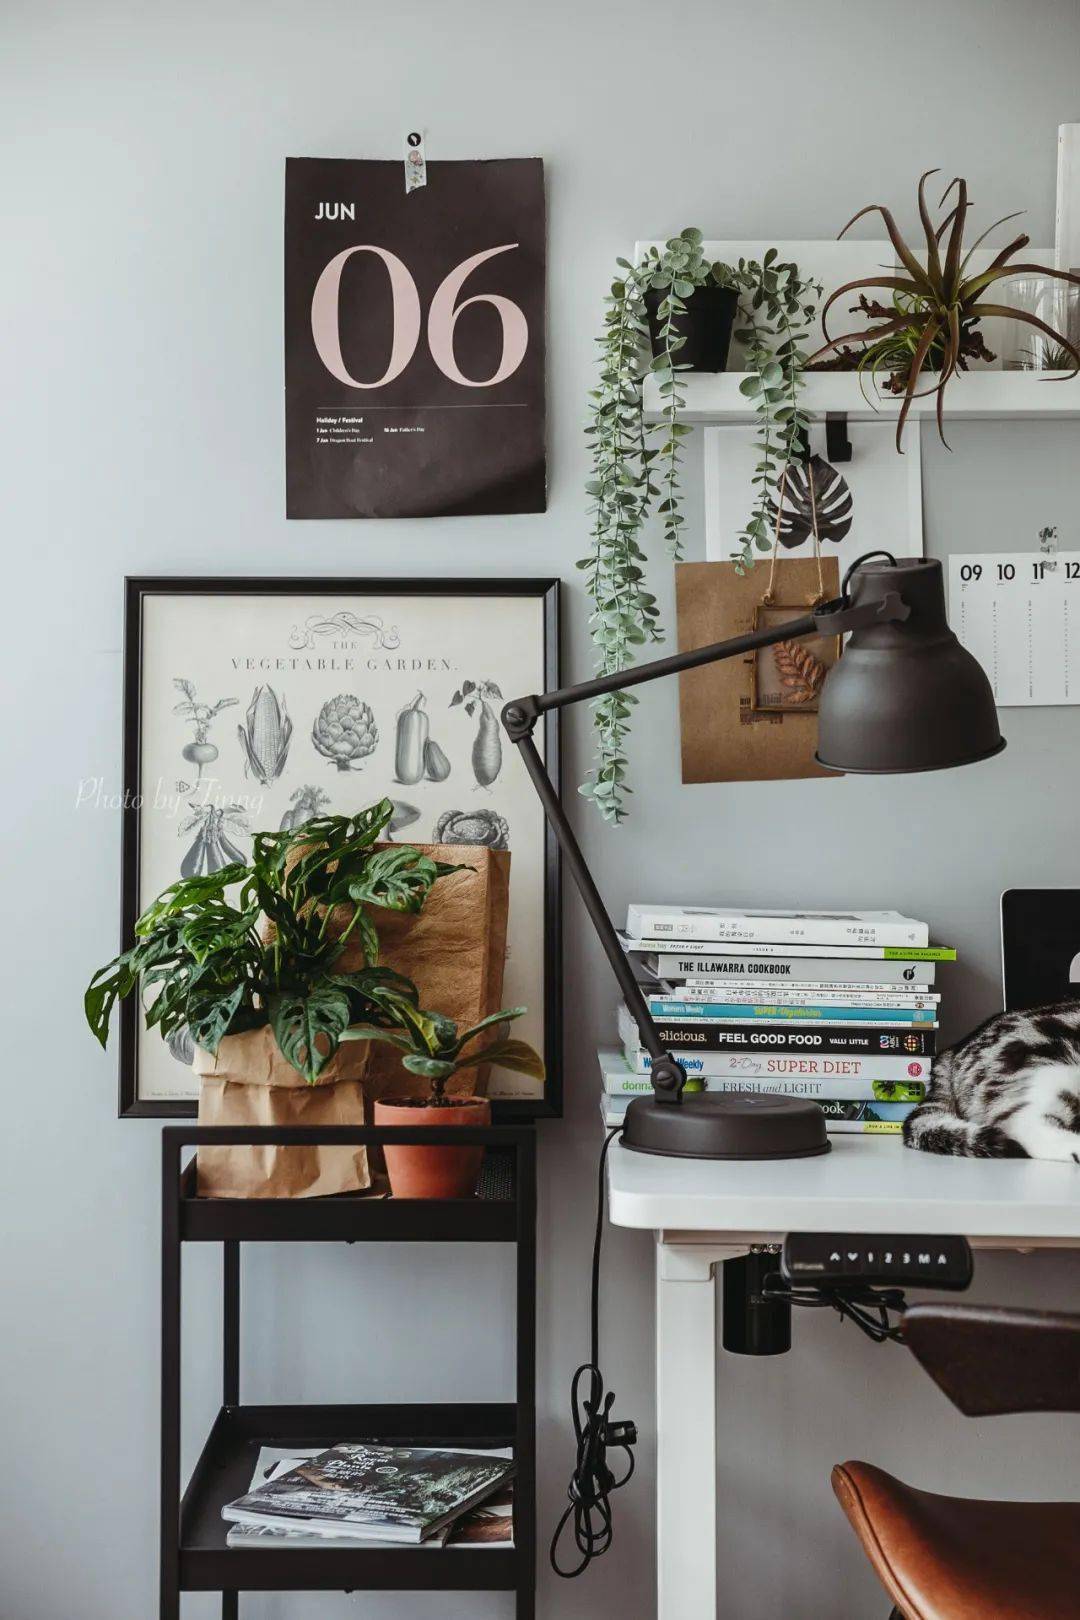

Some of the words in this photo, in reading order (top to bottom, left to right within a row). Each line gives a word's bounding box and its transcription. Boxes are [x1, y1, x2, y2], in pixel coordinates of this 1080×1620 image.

[314, 202, 356, 221] JUN
[311, 243, 529, 389] 06
[316, 417, 338, 425] Holiday
[960, 564, 983, 581] 09
[997, 564, 1016, 580] 10
[1032, 563, 1044, 579] 11
[1064, 562, 1080, 579] 12
[333, 641, 359, 650] THE
[231, 658, 355, 671] VEGETABLE
[367, 658, 459, 671] GARDEN.
[678, 961, 694, 972] THE
[697, 962, 745, 973] ILLAWARRA
[747, 964, 791, 974] COOKBOOK
[659, 1030, 708, 1042] elicious.
[719, 1032, 748, 1043] FEEL
[750, 1033, 786, 1044] GOOD
[788, 1034, 822, 1045] FOOD
[849, 1038, 869, 1046] LITTLE
[676, 1057, 704, 1071] Weekly
[767, 1059, 819, 1073] SUPER
[823, 1060, 862, 1074] DIET
[723, 1082, 761, 1093] FRESH
[762, 1083, 782, 1093] and
[784, 1083, 822, 1094] LIGHT
[821, 1101, 845, 1114] ook
[867, 1252, 874, 1263] 1
[884, 1252, 893, 1264] 2
[902, 1253, 911, 1264] 3
[918, 1253, 931, 1264] M
